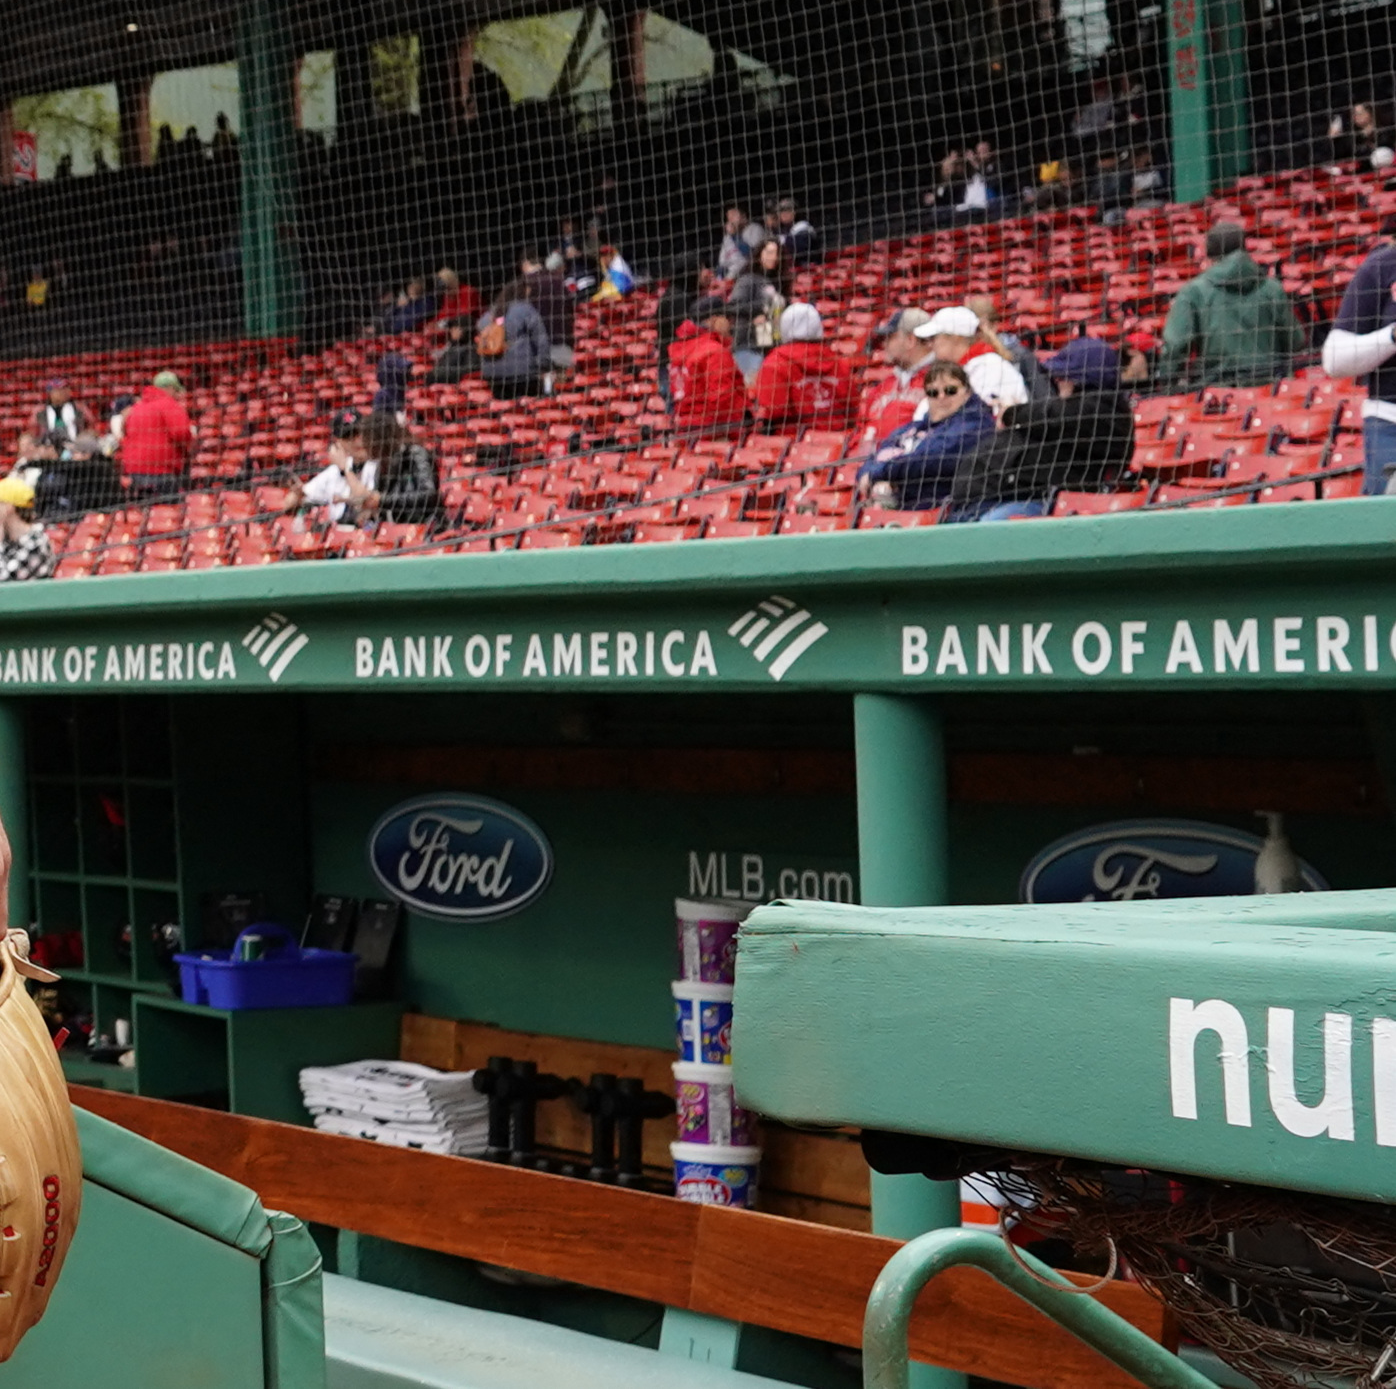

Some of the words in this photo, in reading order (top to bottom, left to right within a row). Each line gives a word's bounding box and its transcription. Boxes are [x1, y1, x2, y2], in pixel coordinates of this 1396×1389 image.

[64, 644, 97, 683] OF
[103, 641, 236, 682] AMERICA
[354, 635, 454, 678] BANK
[464, 634, 513, 678] OF
[522, 629, 720, 677] AMERICA
[901, 622, 1053, 675] BANK
[1071, 621, 1148, 675] OF
[1165, 615, 1396, 673] AMERI
[398, 812, 514, 899] Ford
[689, 851, 853, 903] MLB.com
[36, 1175, 61, 1288] A2000
